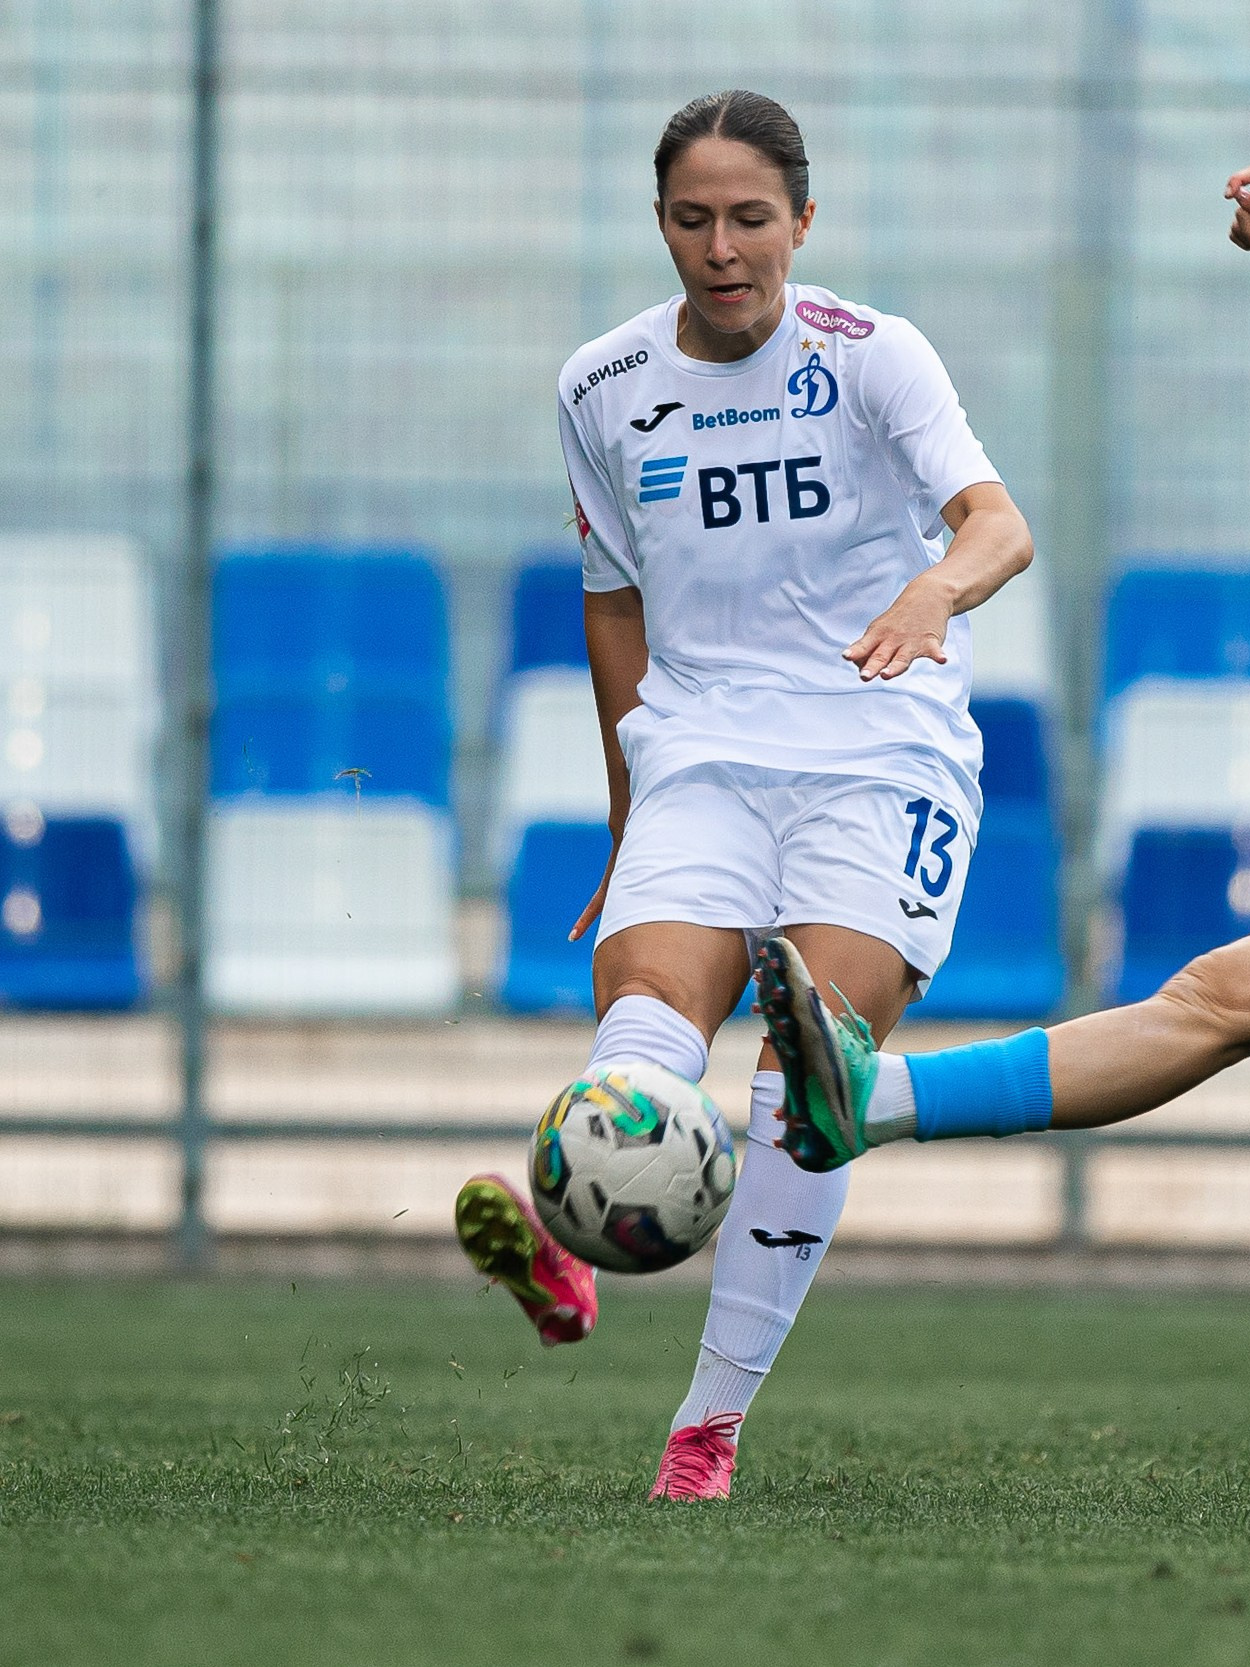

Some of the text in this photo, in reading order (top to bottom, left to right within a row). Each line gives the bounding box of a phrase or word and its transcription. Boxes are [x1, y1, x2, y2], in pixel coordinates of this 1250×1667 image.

[692, 408, 780, 430] BetBoom
[698, 455, 831, 530] ВТБ
[904, 796, 958, 897] 13
[795, 1244, 811, 1261] 13
